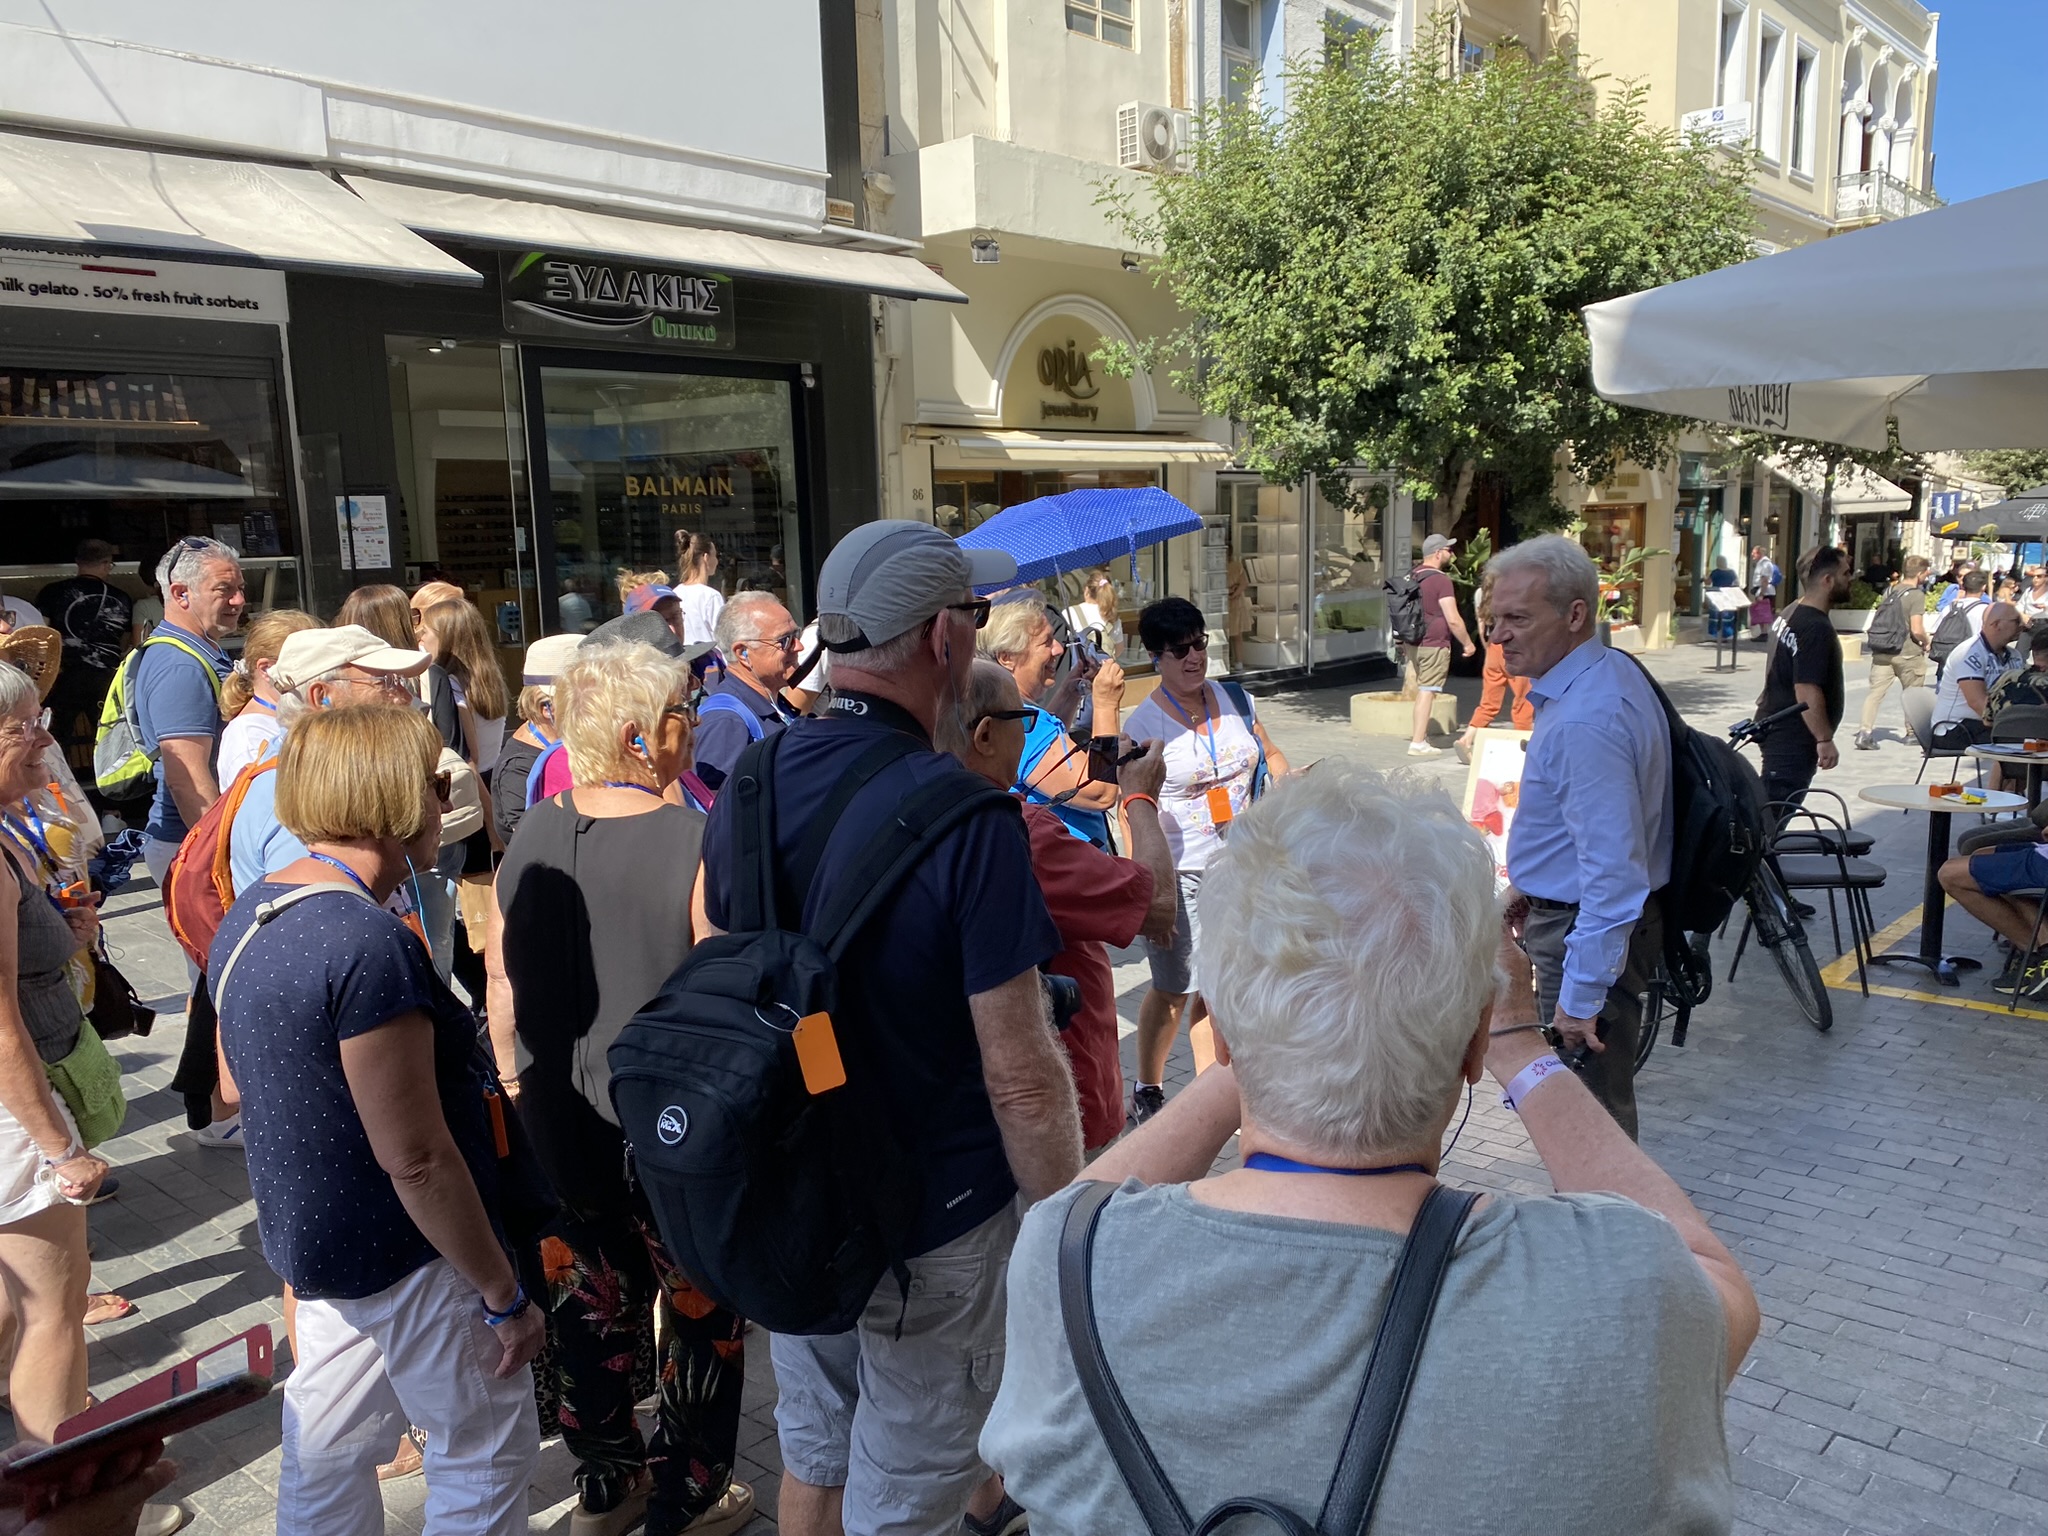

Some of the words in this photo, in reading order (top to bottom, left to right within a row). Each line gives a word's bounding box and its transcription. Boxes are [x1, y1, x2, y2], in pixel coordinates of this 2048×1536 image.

[28, 281, 79, 296] gelato
[93, 285, 129, 301] 50%
[132, 289, 170, 304] fresh
[174, 292, 204, 307] fruit
[206, 293, 259, 310] sorbets
[544, 261, 720, 315] ΞΥΔΑΚΗΣ
[625, 476, 733, 496] BALMAIN
[912, 488, 924, 501] 86
[661, 503, 702, 514] PARIS
